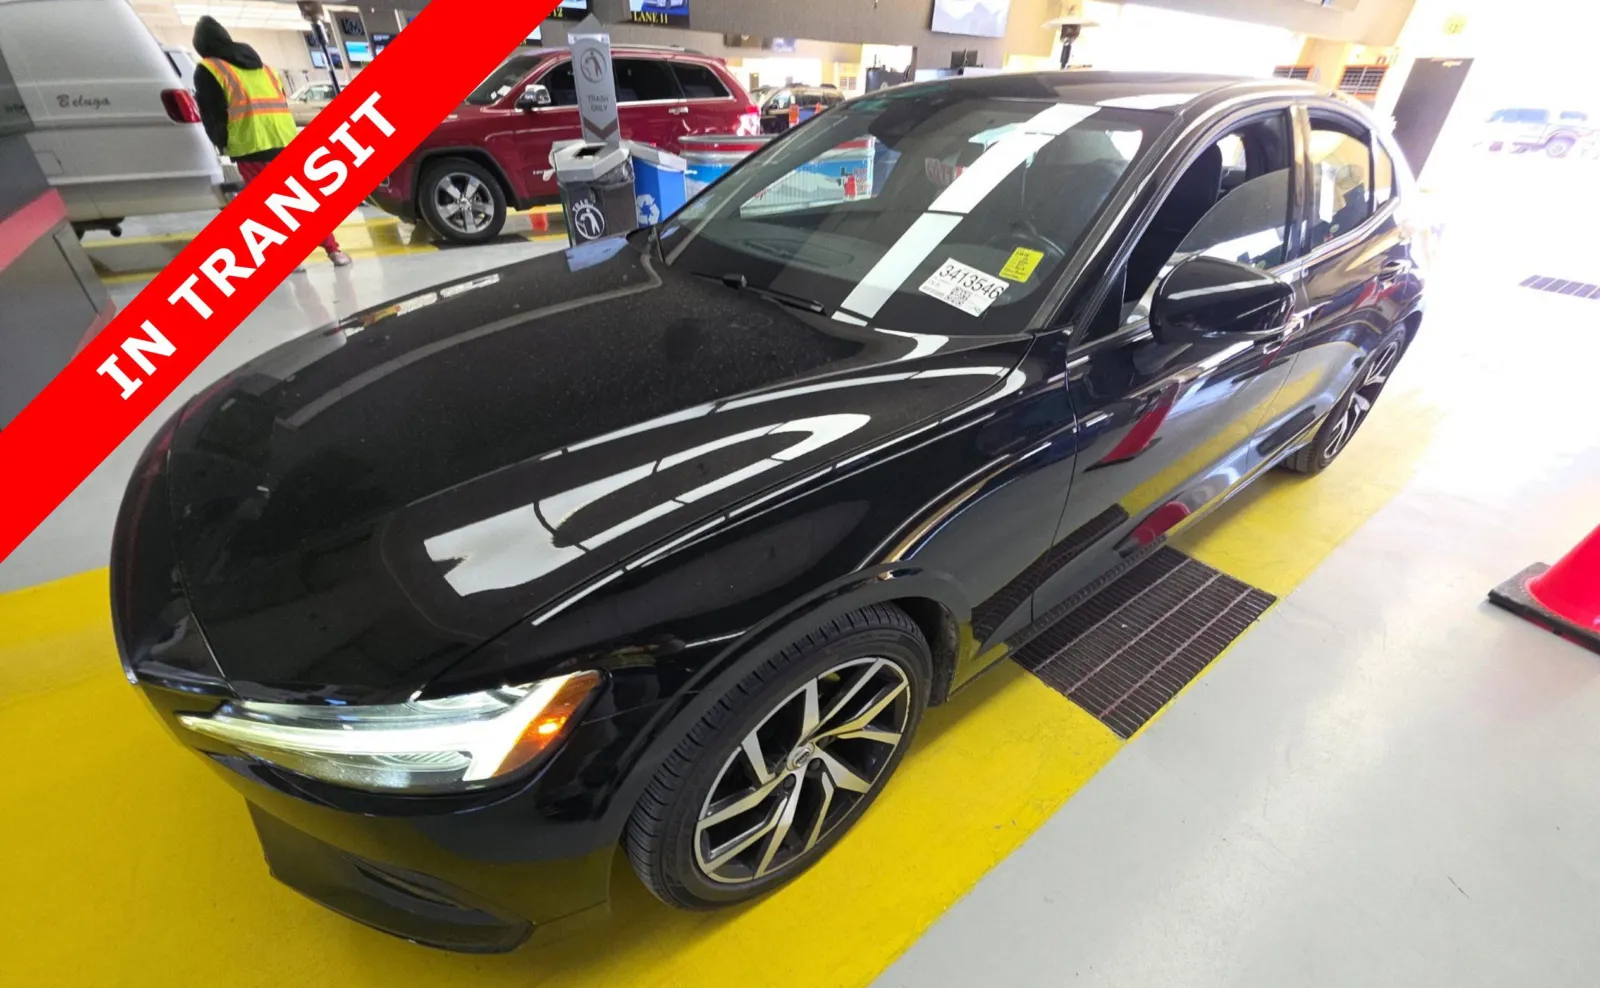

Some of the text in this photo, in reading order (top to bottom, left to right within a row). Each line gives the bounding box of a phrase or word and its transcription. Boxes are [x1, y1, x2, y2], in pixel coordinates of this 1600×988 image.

[633, 11, 668, 24] LANE 11
[56, 93, 111, 110] Beluga
[588, 95, 609, 103] TRASH
[590, 104, 608, 112] ONLY
[940, 265, 1005, 300] 3413546
